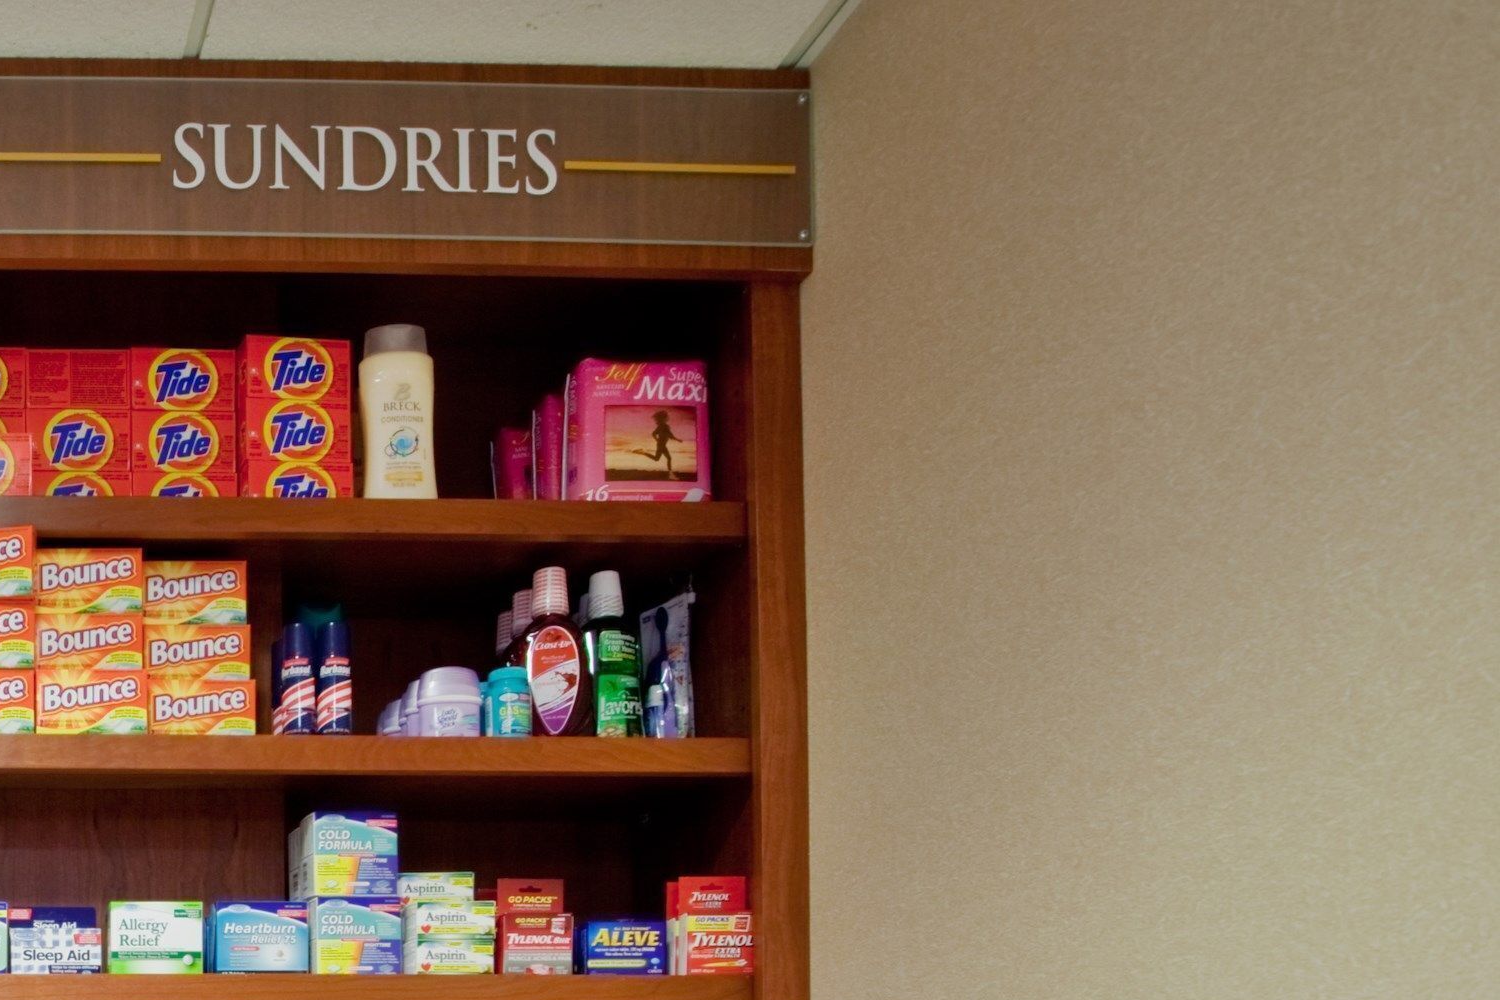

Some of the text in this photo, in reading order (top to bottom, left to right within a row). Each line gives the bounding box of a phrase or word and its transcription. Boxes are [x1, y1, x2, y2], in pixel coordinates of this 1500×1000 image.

[172, 122, 560, 195] SUNDRIES
[272, 350, 326, 391] Tide
[156, 361, 211, 402] Tide
[383, 402, 421, 412] BRECK
[271, 412, 326, 454] Tide
[51, 422, 106, 464] Tide
[156, 424, 211, 466] Tide
[585, 484, 609, 502] 16
[41, 558, 132, 590] Bounce
[147, 570, 236, 601] Bounce
[41, 623, 132, 656] Bounce
[151, 634, 240, 666] Bounce
[43, 678, 137, 712] Bounce
[154, 690, 245, 722] Bounce
[318, 830, 351, 840] COLD
[318, 841, 373, 850] FORMULA
[404, 884, 445, 896] Aspirin
[690, 892, 730, 902] TYLENOL
[508, 896, 552, 904] GO PACKS
[321, 915, 354, 924] COLD
[424, 912, 468, 924] Aspirin
[118, 919, 168, 934] Allergy
[224, 922, 296, 934] Heartburn
[321, 925, 376, 935] FORMULA
[119, 934, 160, 946] Relief
[250, 935, 296, 944] Relief 75
[507, 933, 553, 944] TYLENOL
[591, 928, 660, 946] ALEVE
[691, 932, 754, 948] TYLENOL
[22, 950, 90, 963] Sleep Aid
[425, 950, 466, 962] Aspirin
